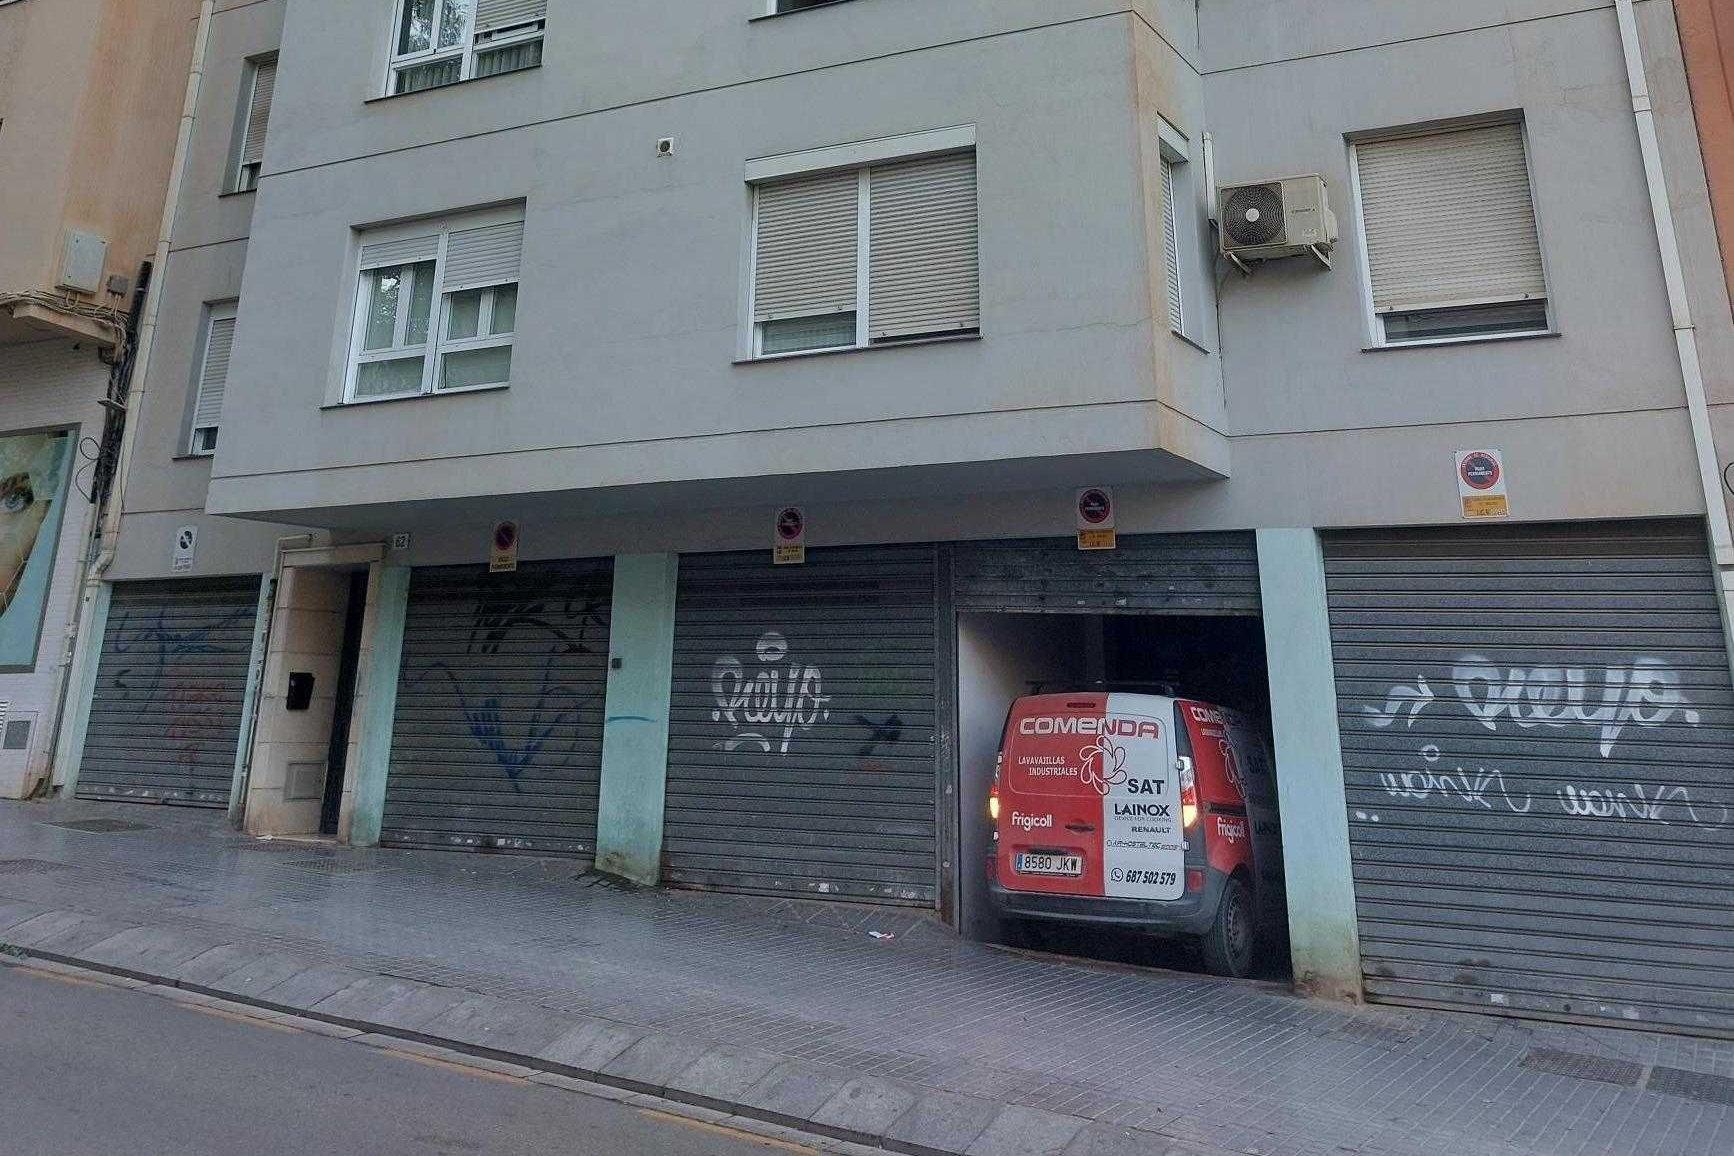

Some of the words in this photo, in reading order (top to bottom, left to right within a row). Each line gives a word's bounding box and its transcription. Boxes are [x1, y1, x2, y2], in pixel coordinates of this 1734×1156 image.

[1020, 717, 1160, 739] COMENDA
[1018, 756, 1065, 765] LAVAVAJILLAS
[1029, 767, 1078, 776] INDUSTRIALES
[1127, 778, 1164, 795] SAT
[1114, 803, 1170, 817] LAINOX
[1131, 826, 1171, 834] RENAULT
[1024, 856, 1052, 870] 8580
[1056, 857, 1078, 872] JKW
[1126, 869, 1142, 883] 687
[1143, 871, 1159, 884] 502
[1160, 872, 1176, 885] 579
